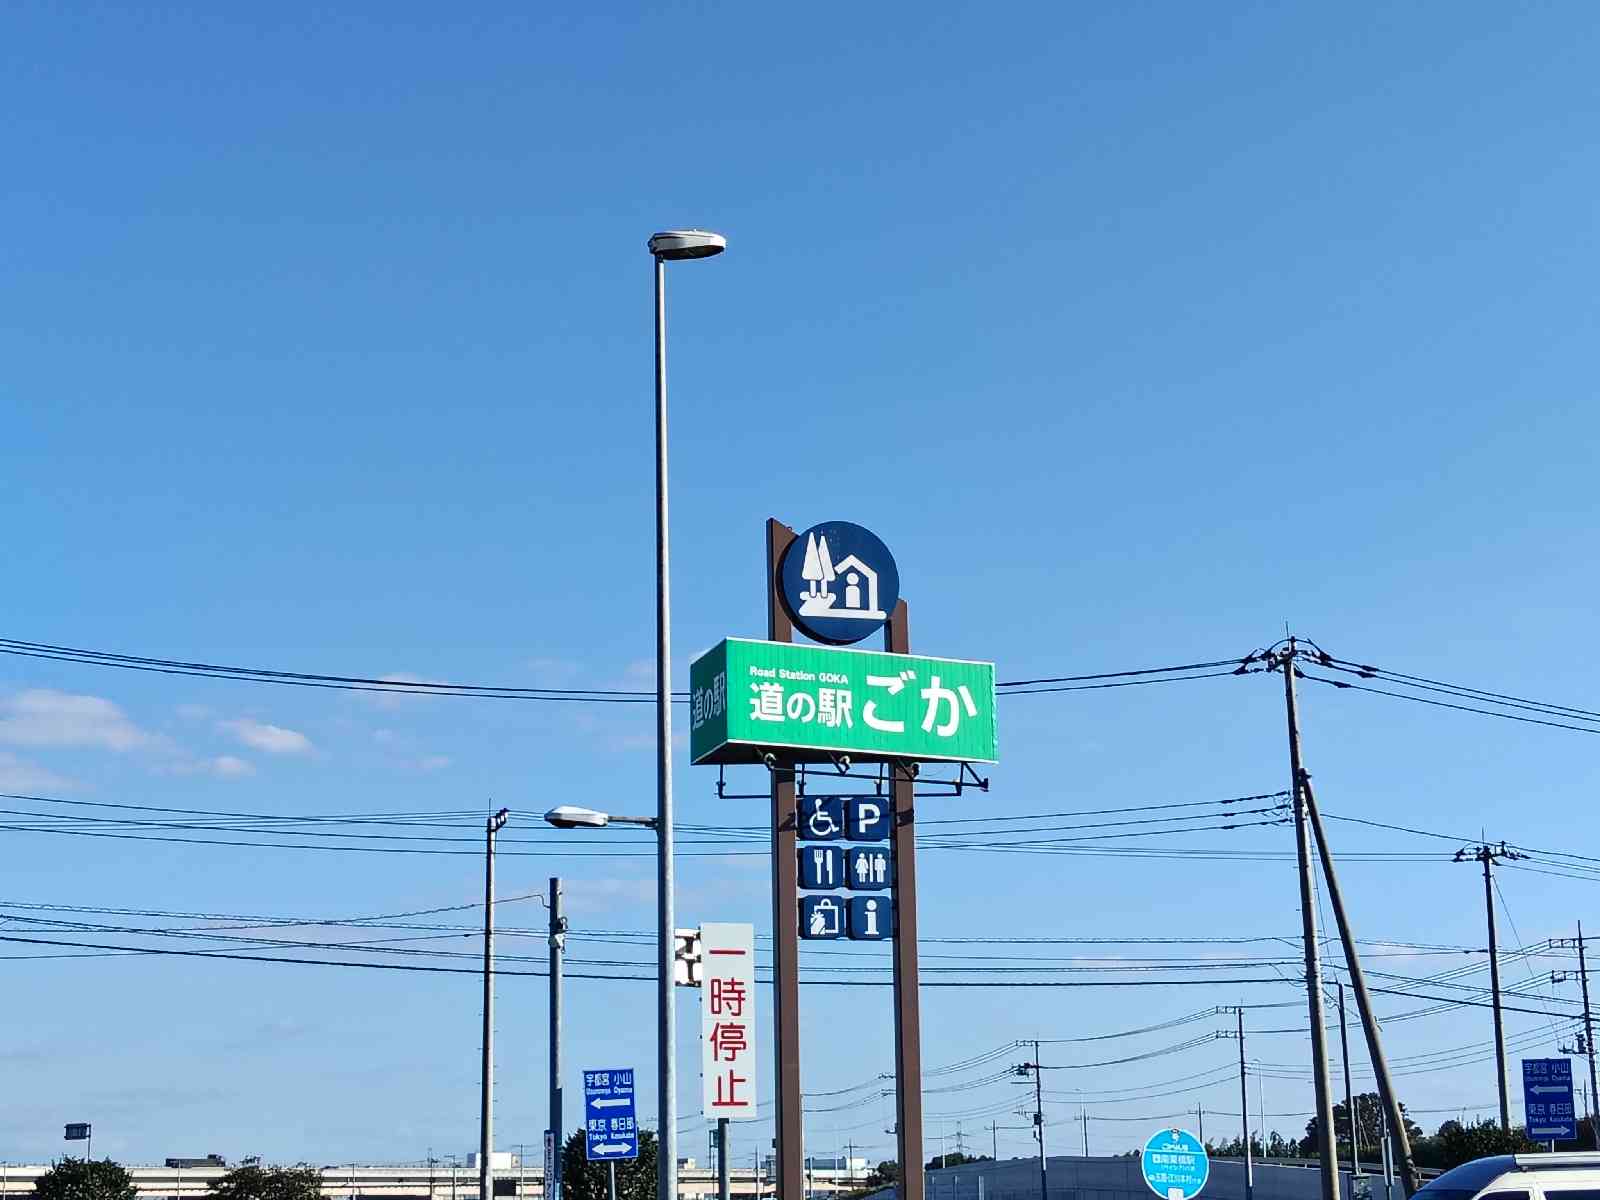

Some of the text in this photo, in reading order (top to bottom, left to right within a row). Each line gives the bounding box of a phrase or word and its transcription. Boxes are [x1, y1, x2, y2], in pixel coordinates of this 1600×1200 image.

[750, 665, 849, 685] Road Station GOKA
[692, 671, 726, 731] 道の駅
[749, 669, 979, 738] 道の駅 ごか
[858, 803, 881, 834] P
[708, 949, 749, 1107] 一時停止
[614, 1072, 632, 1085] 小山
[589, 1119, 607, 1131] 東京
